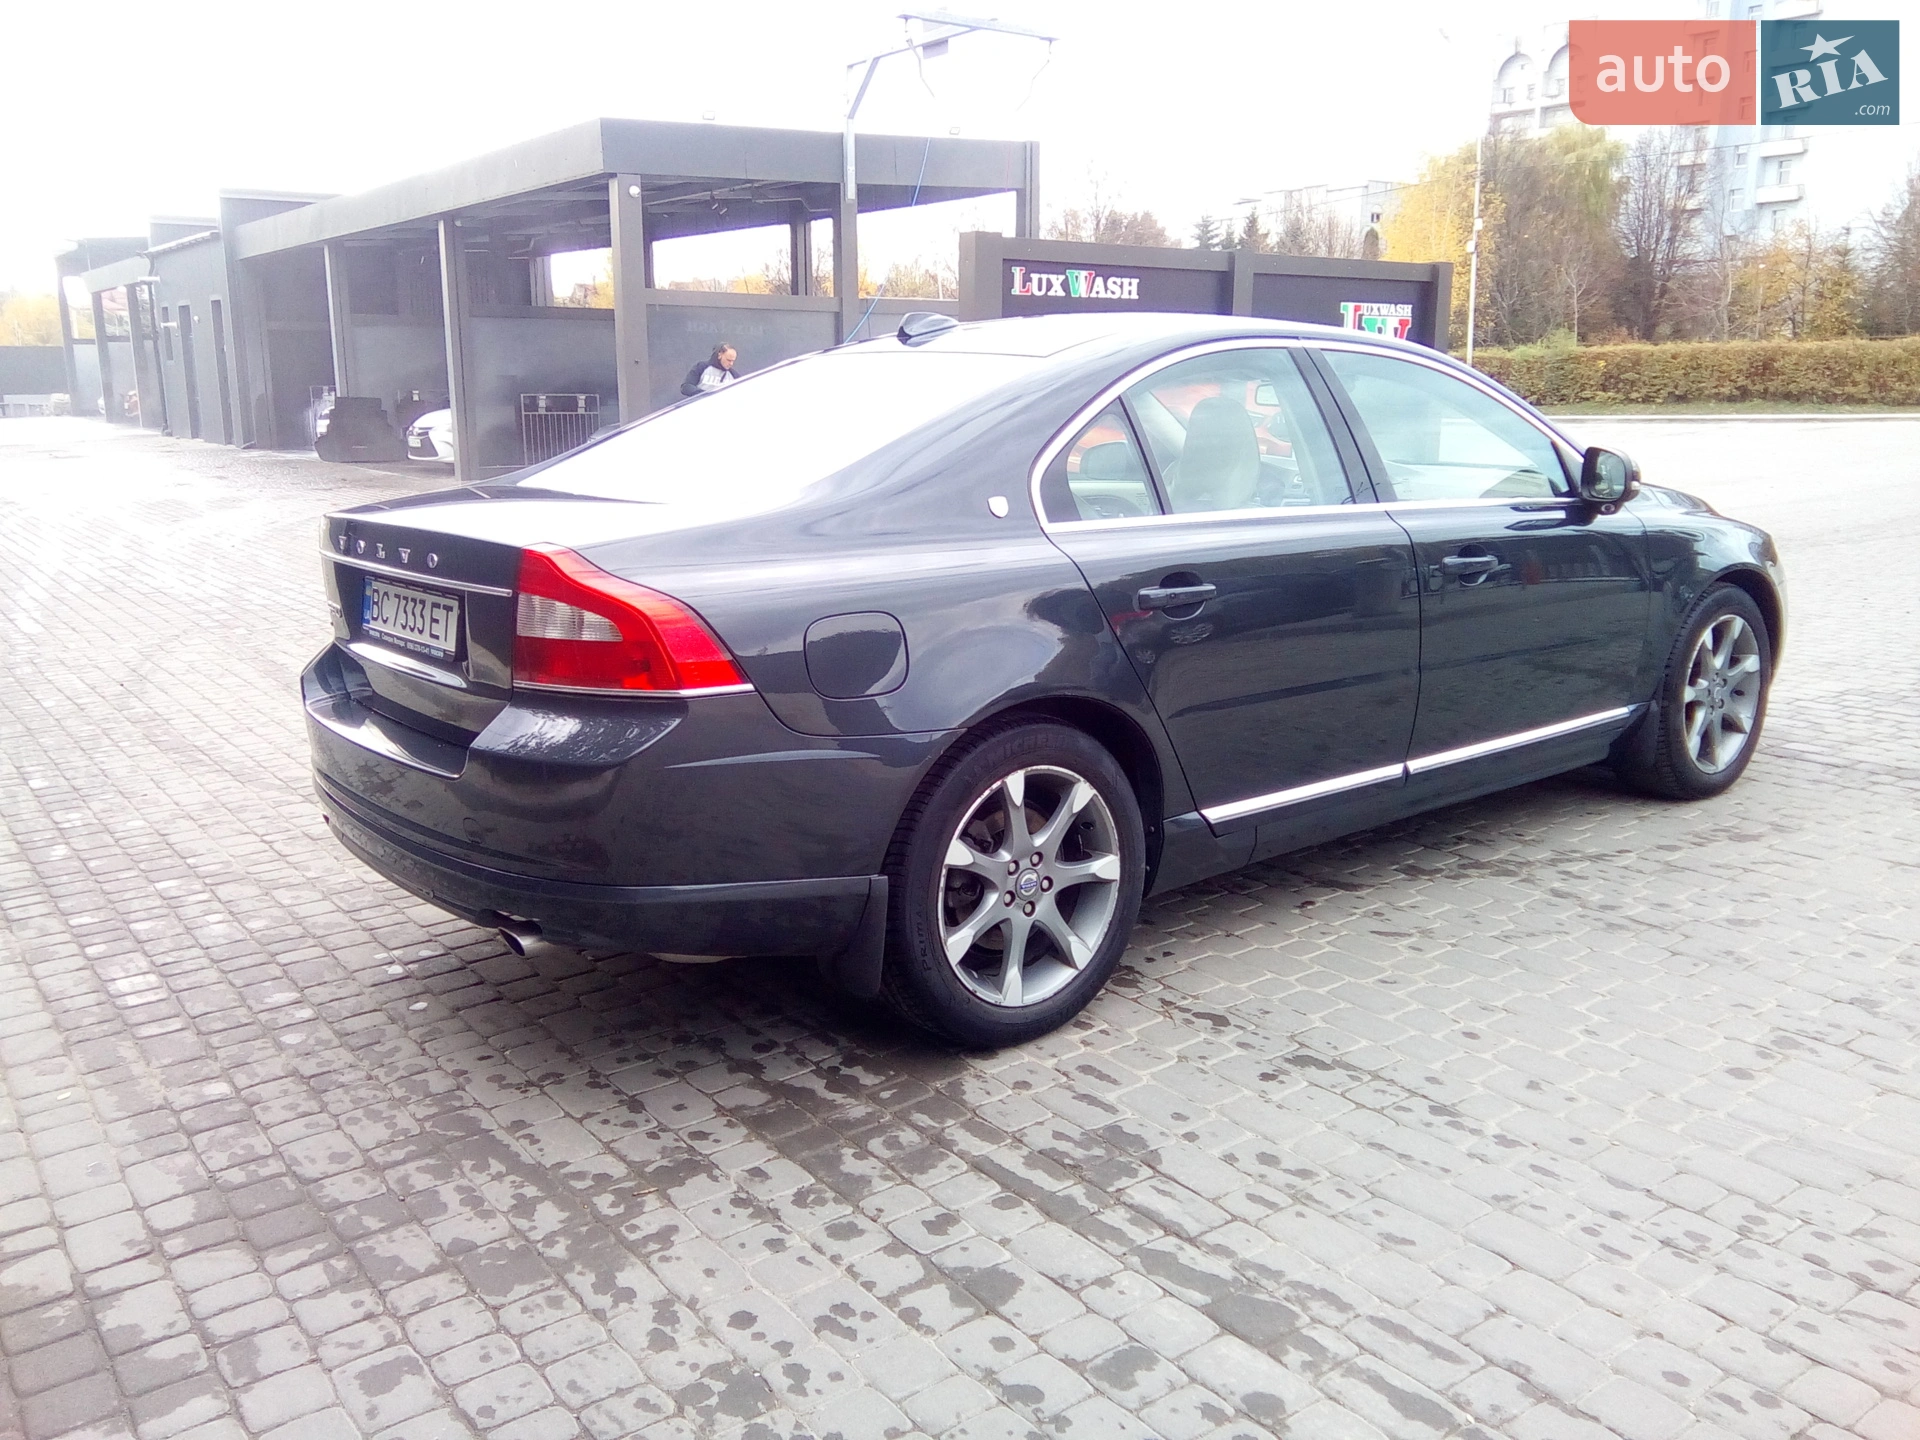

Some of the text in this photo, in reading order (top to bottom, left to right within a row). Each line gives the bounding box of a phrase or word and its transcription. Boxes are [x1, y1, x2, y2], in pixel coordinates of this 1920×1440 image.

[338, 535, 439, 568] VOLVO
[371, 587, 390, 625] BC
[393, 593, 427, 635] 7333
[429, 602, 454, 643] ET
